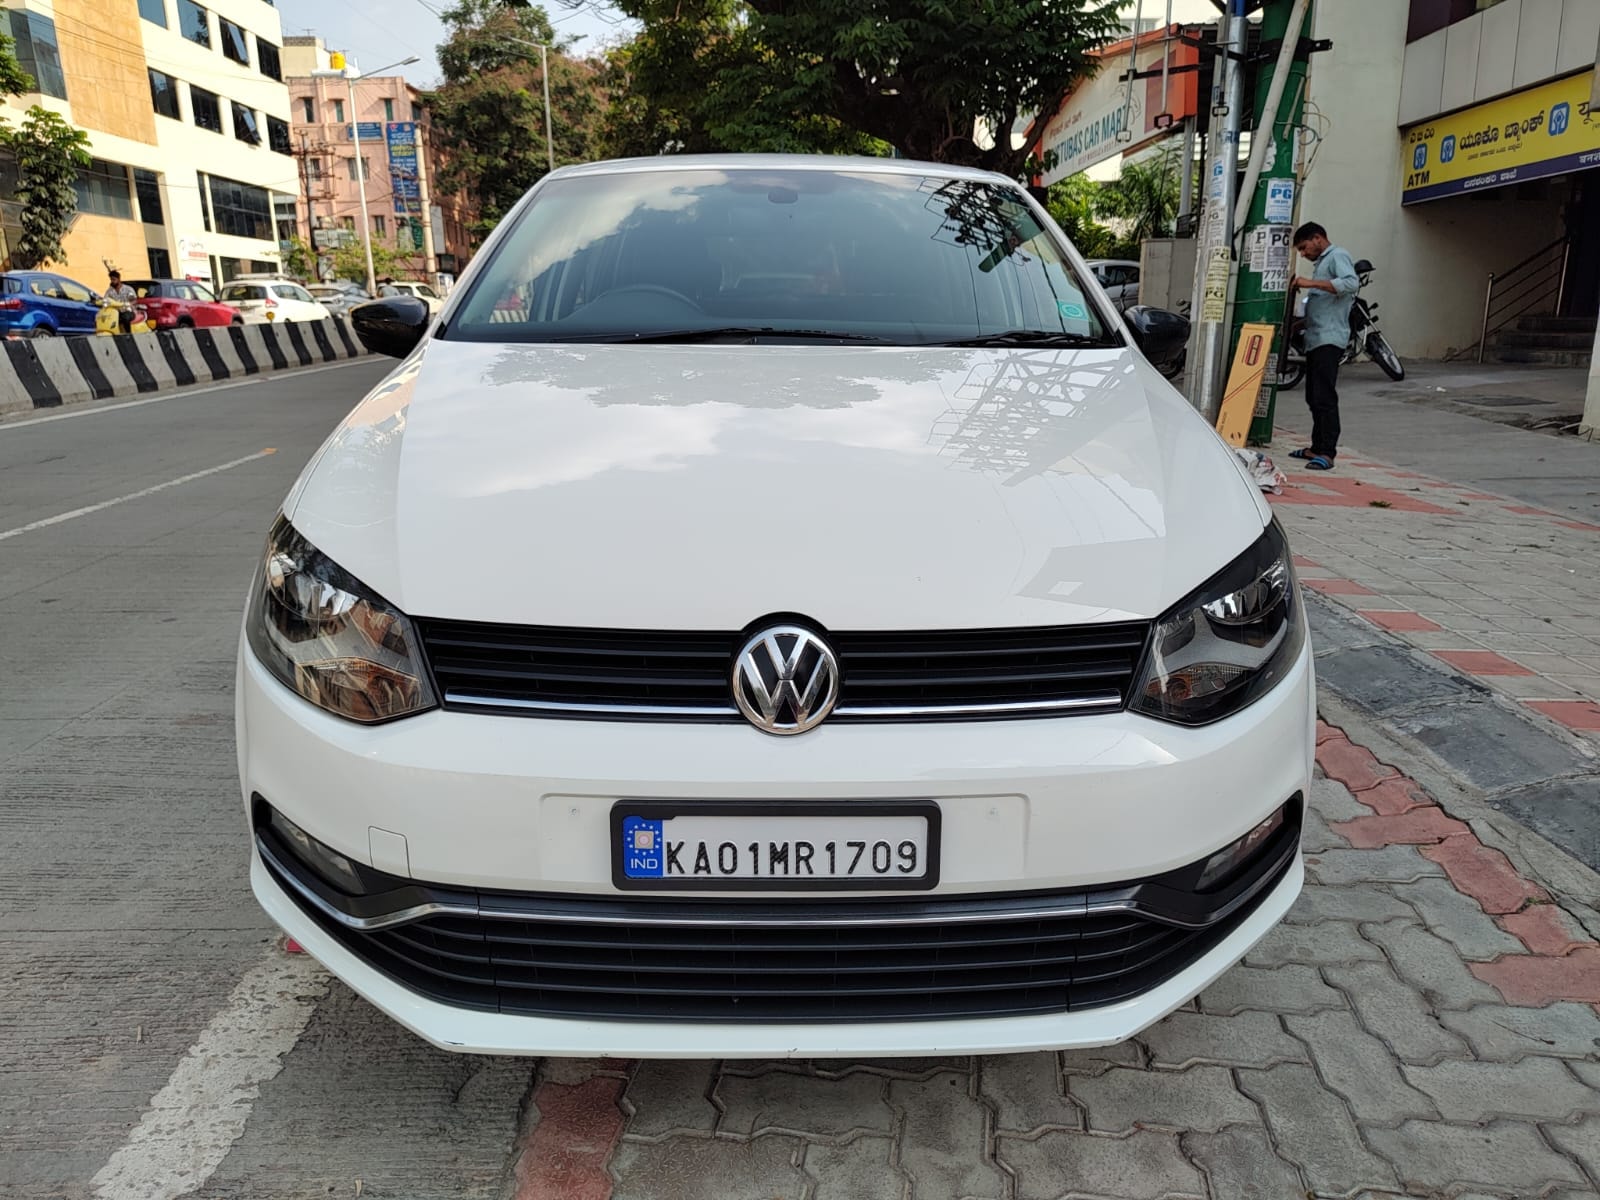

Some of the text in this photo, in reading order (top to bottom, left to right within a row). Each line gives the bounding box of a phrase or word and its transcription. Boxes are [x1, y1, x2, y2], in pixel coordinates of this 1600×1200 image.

[1084, 120, 1100, 151] CAR
[1407, 170, 1430, 188] ATM
[1270, 188, 1292, 199] PG
[1271, 233, 1290, 246] PG
[1205, 290, 1224, 298] PG
[630, 858, 658, 869] IND
[666, 840, 917, 875] KA01MR1709
